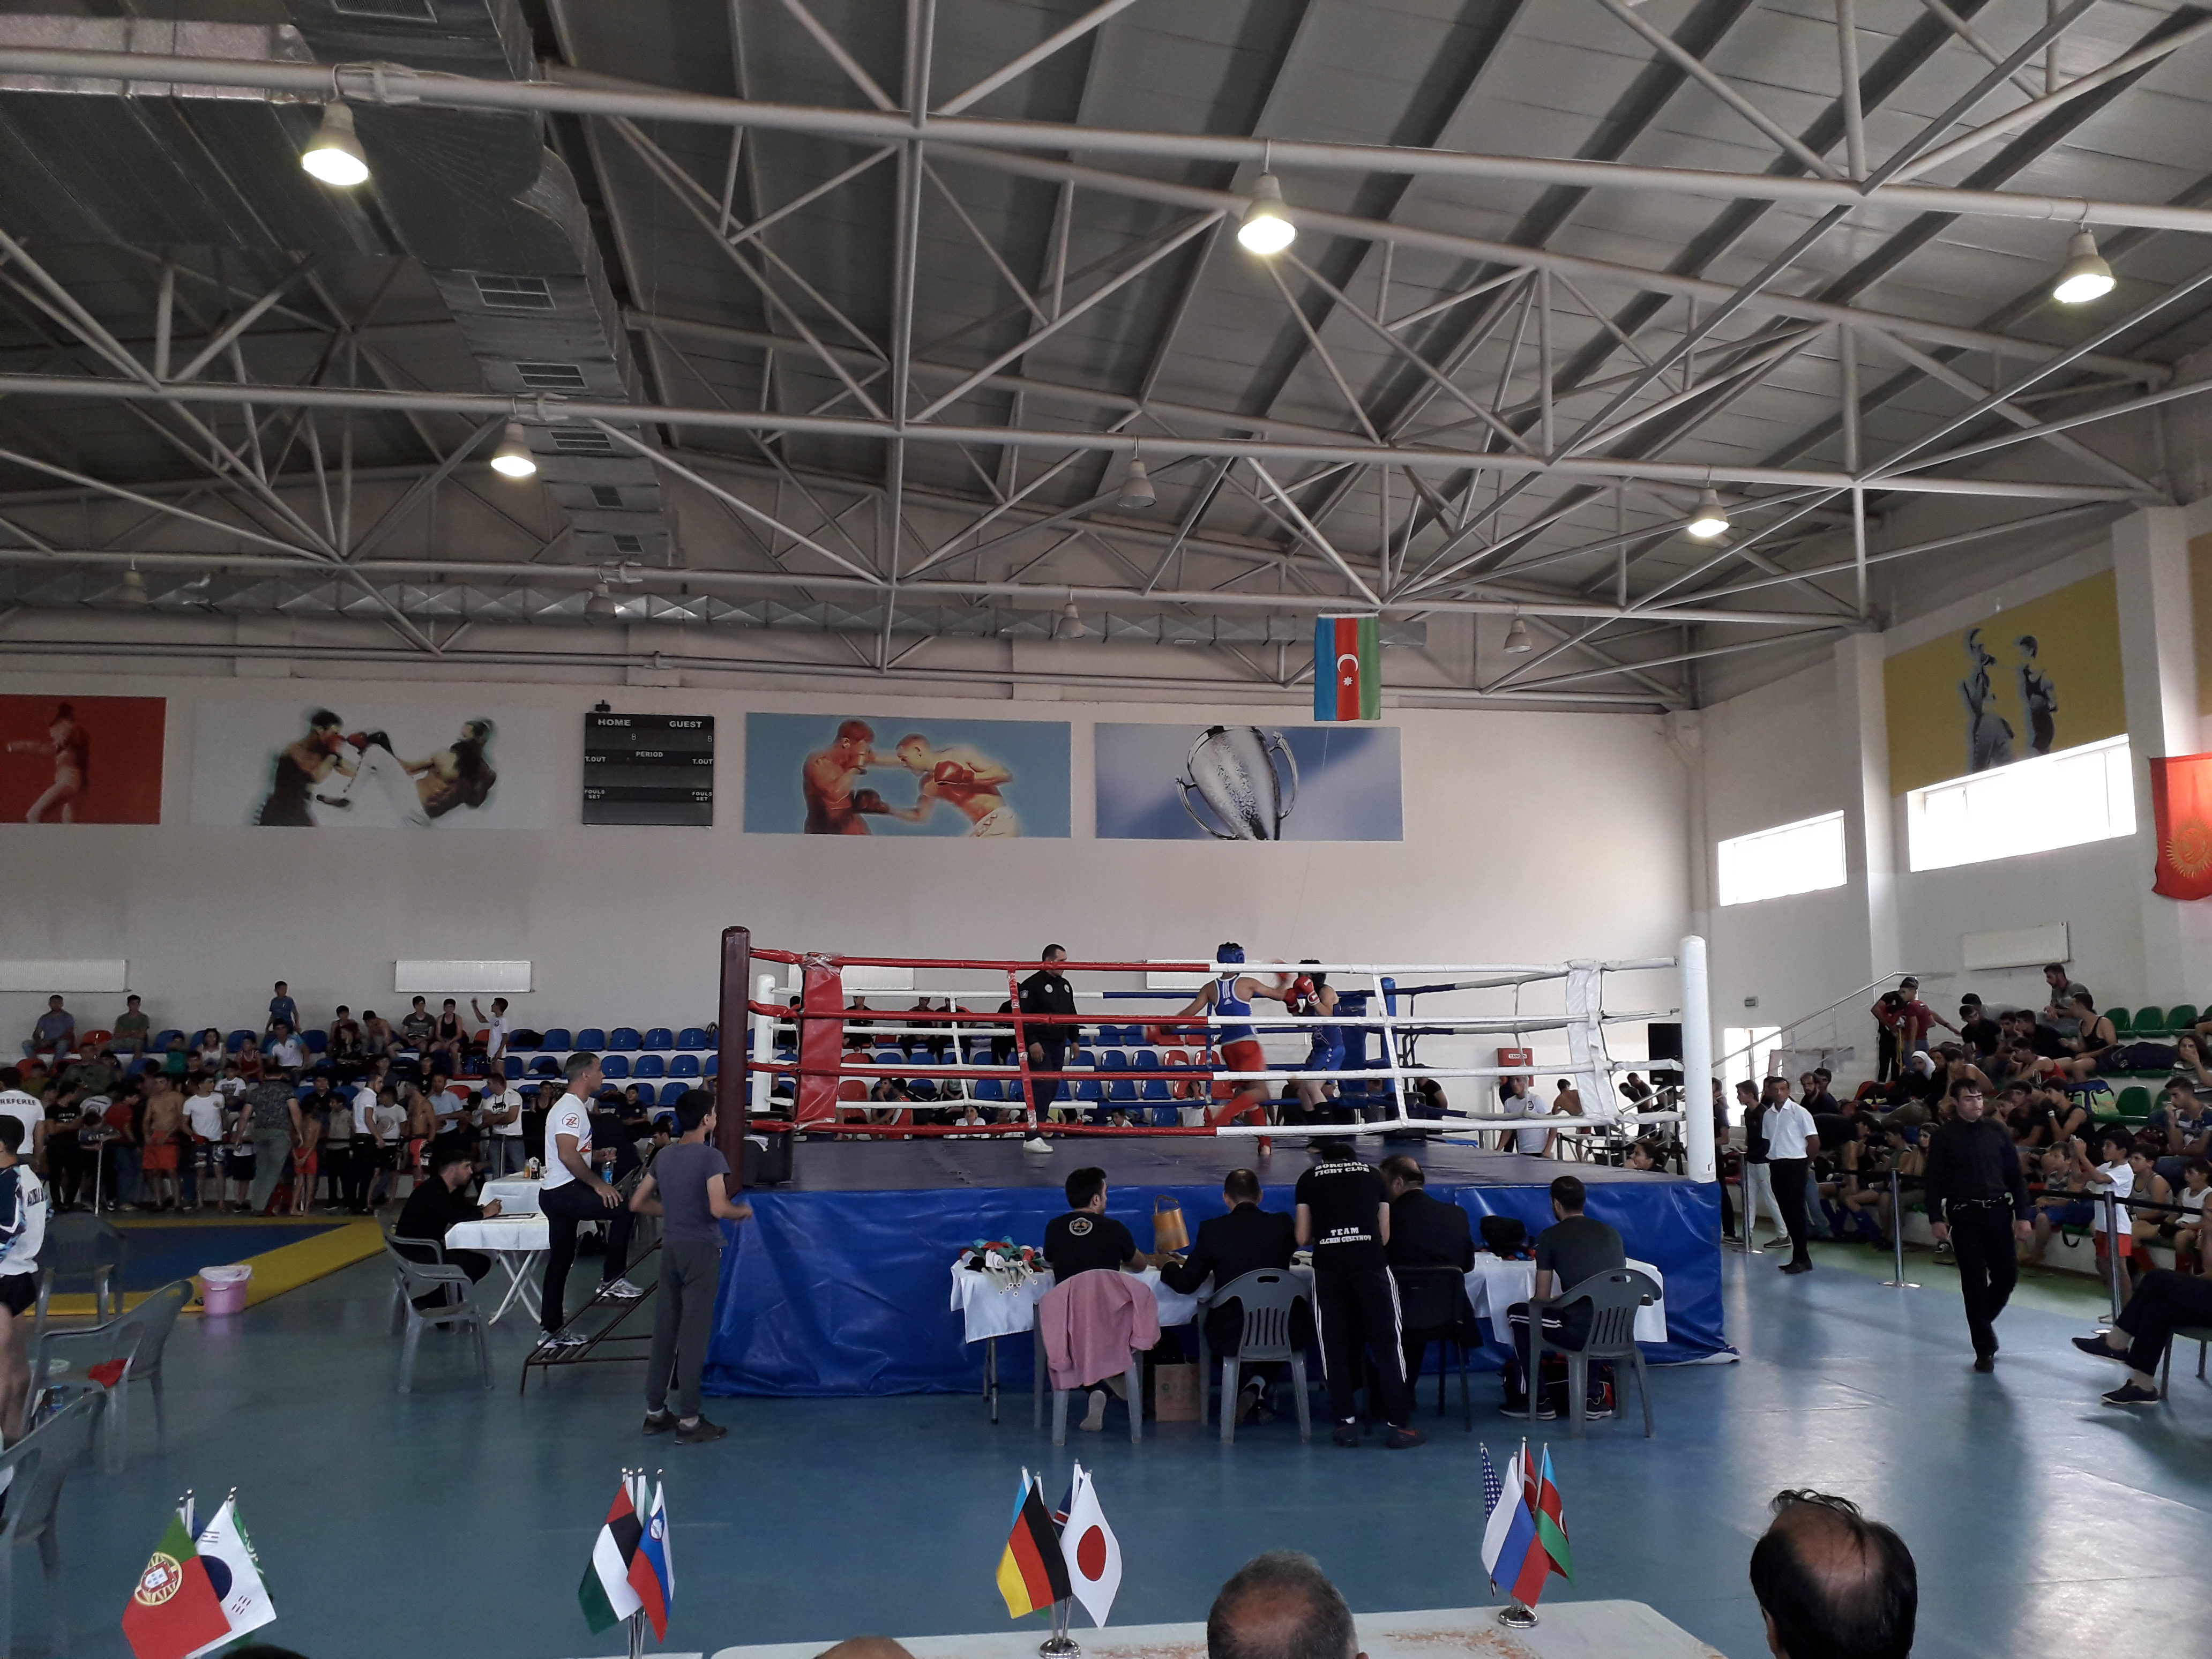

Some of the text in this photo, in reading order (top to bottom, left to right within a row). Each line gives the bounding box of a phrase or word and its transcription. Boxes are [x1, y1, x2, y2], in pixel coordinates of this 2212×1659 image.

[597, 719, 631, 727] HOME
[1314, 1168, 1343, 1177] FIGHT
[1331, 1227, 1359, 1236] TEAM
